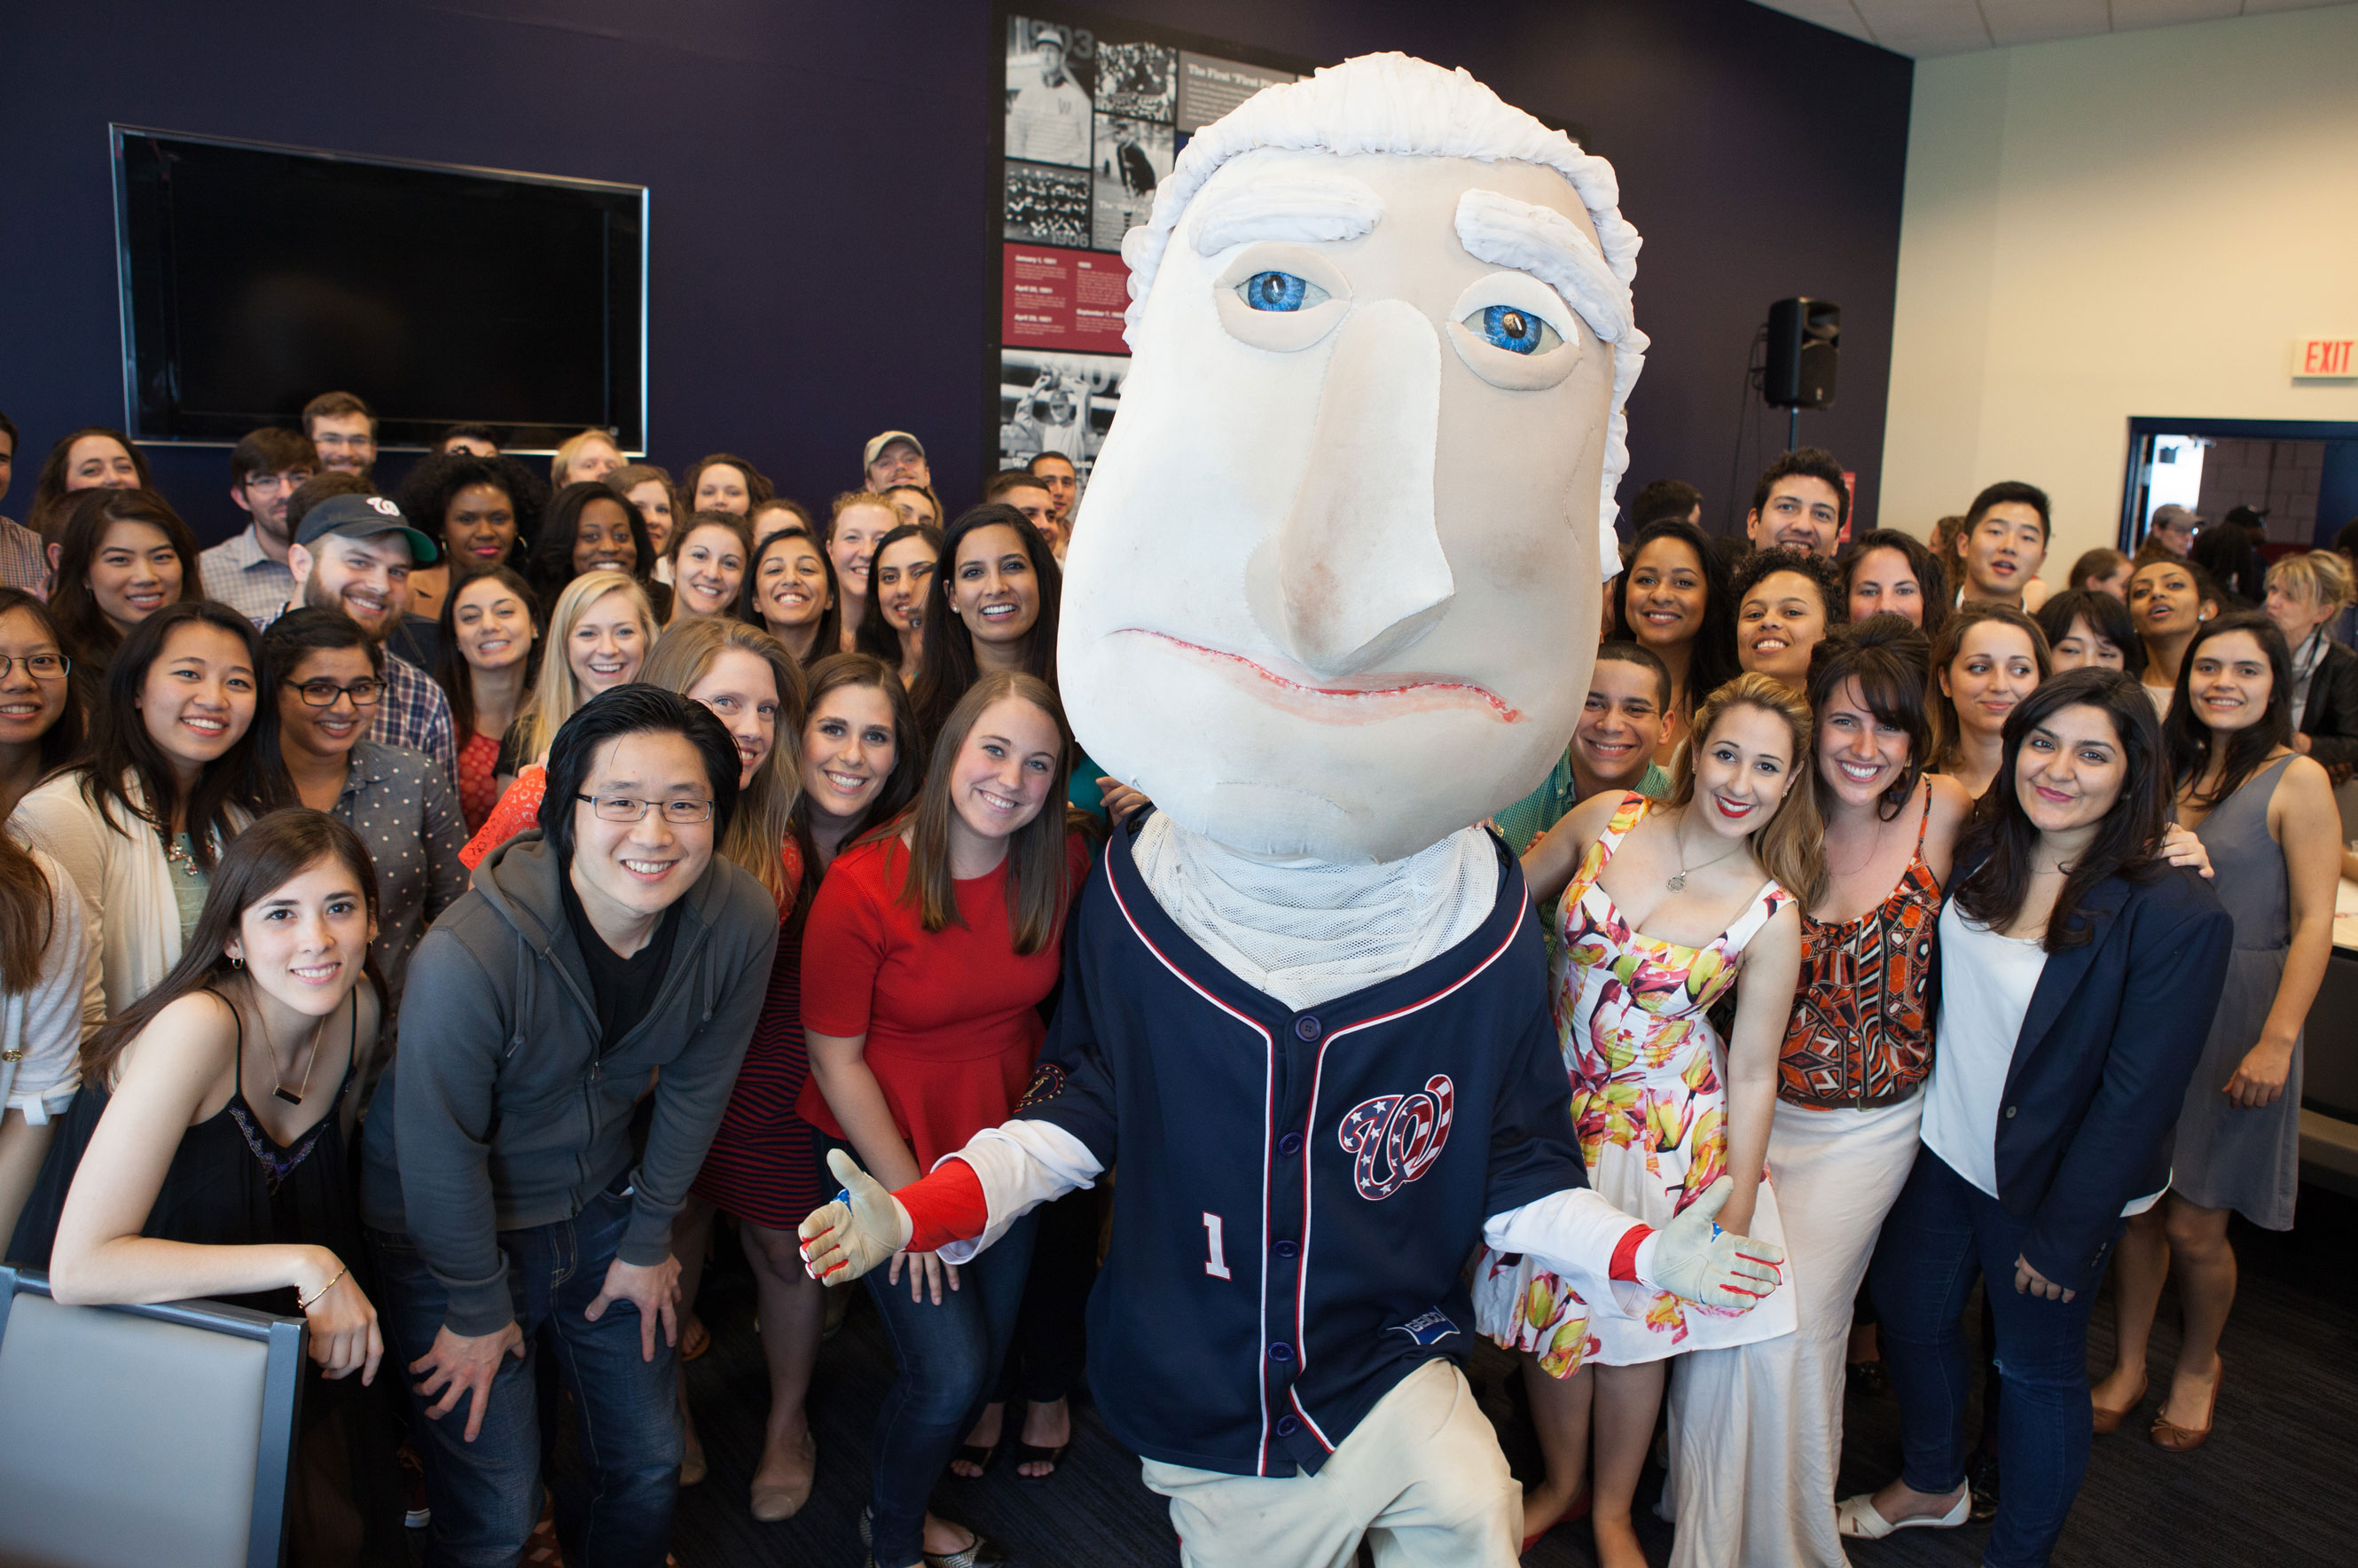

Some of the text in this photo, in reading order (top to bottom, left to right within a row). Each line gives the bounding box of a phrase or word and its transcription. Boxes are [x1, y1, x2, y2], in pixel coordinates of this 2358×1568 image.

[1187, 63, 1206, 78] The
[1207, 67, 1231, 82] First
[1051, 231, 1090, 248] 1906
[2304, 340, 2354, 373] EXIT
[1337, 1073, 1454, 1201] W
[1203, 1210, 1232, 1282] 1
